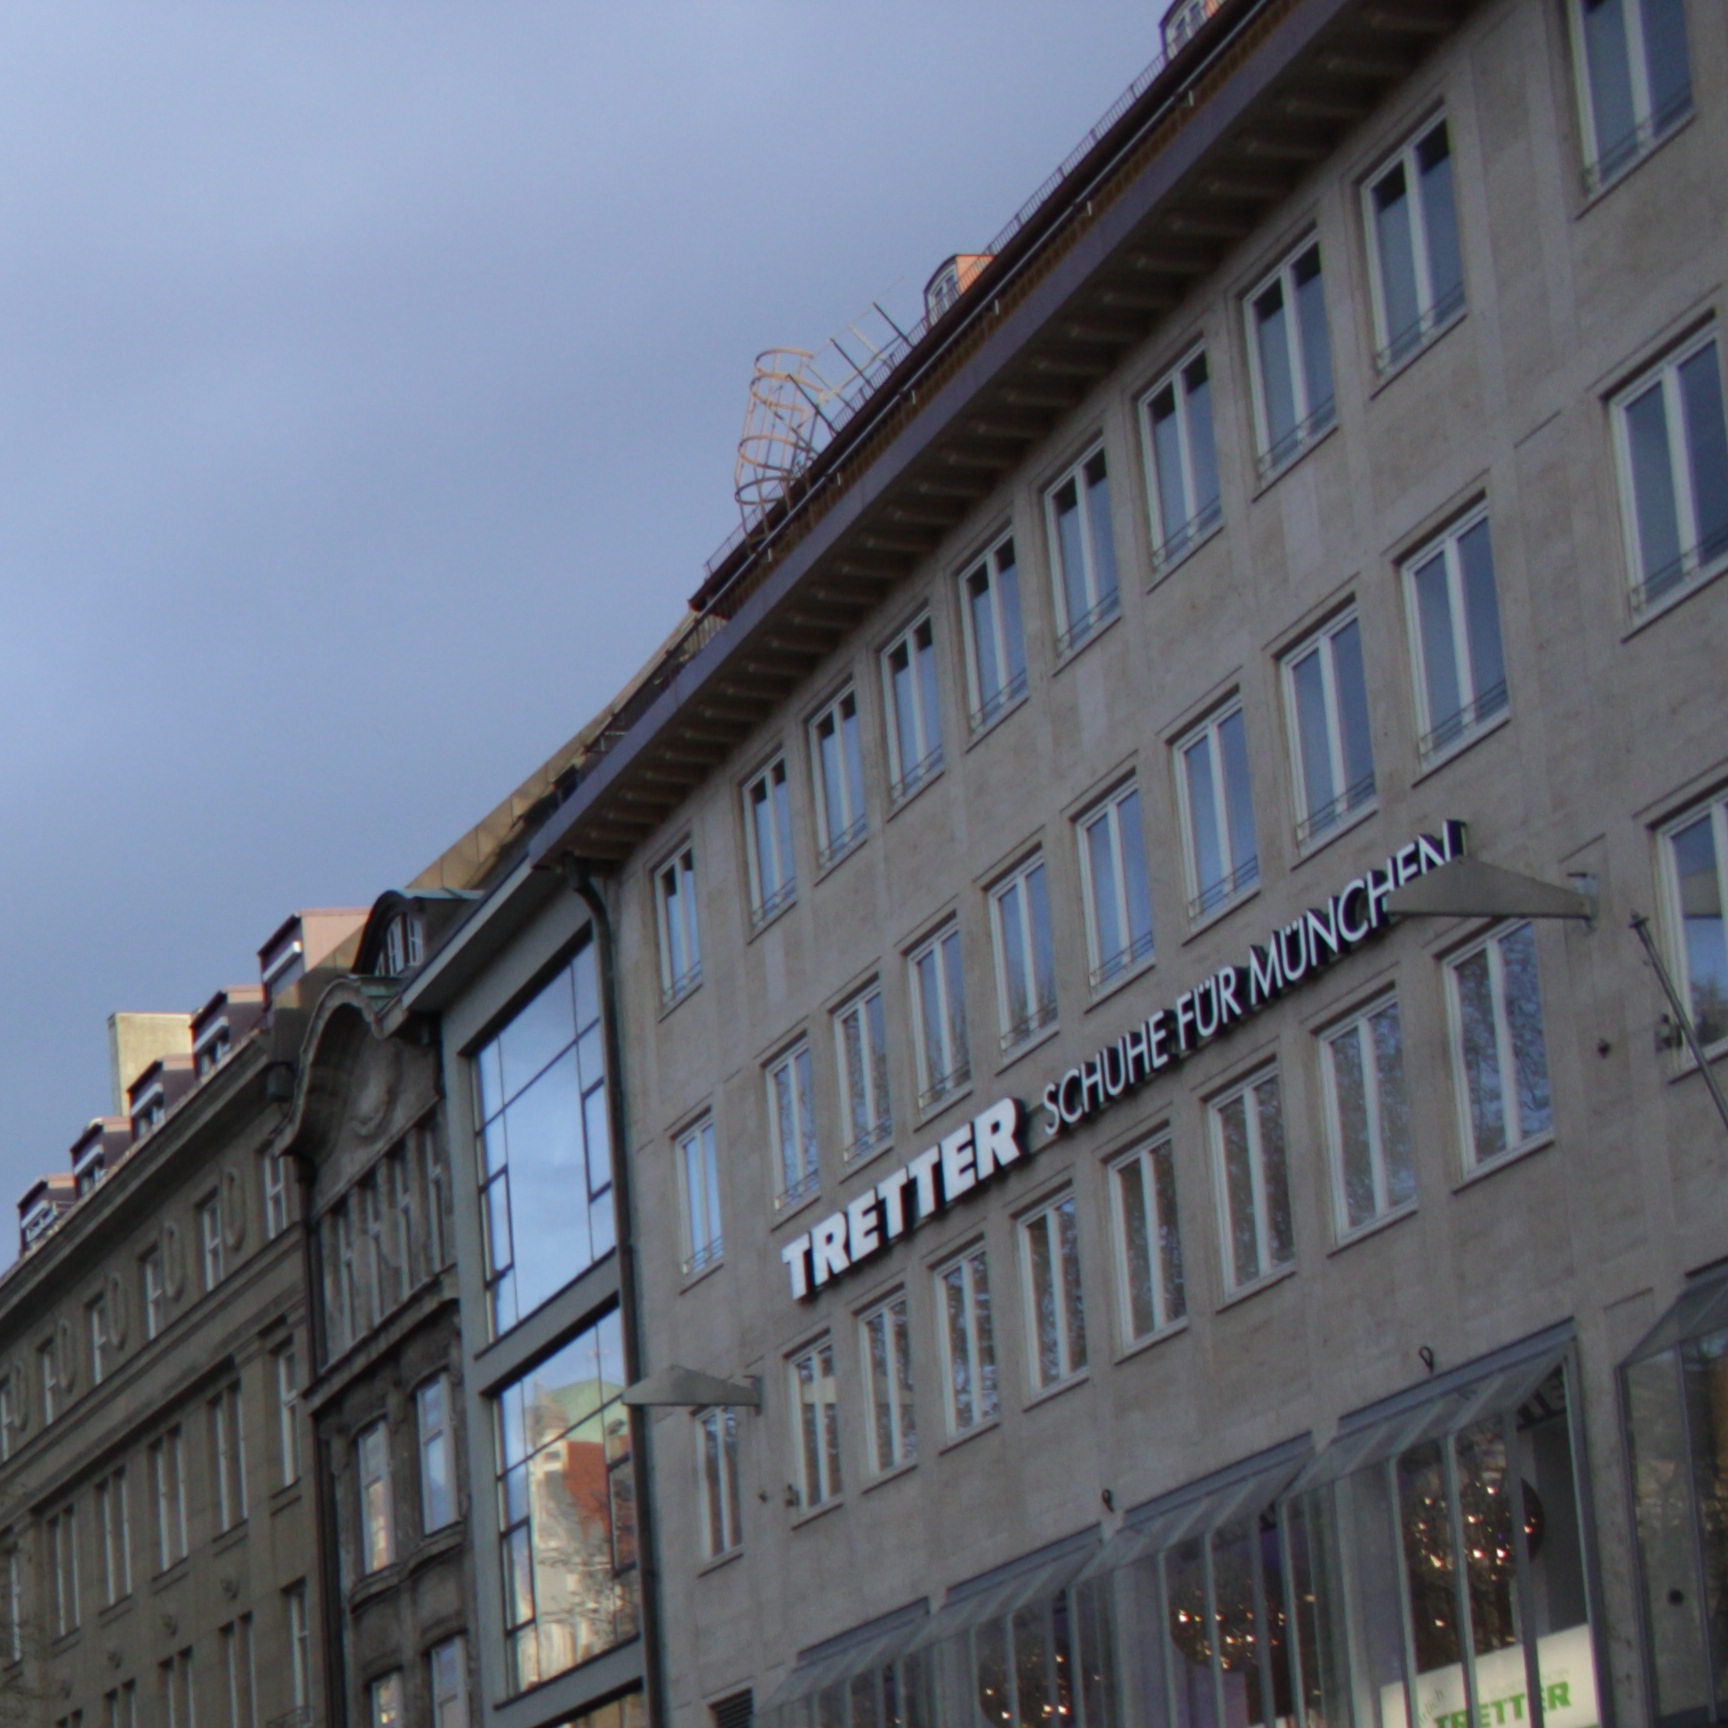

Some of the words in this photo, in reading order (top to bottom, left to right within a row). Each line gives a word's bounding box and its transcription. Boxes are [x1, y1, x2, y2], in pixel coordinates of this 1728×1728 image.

[781, 1097, 1022, 1300] TRETTER
[1044, 1008, 1170, 1136] SCHUHE
[1175, 966, 1242, 1048] FÜR
[1248, 819, 1459, 1005] MÜNCHEN
